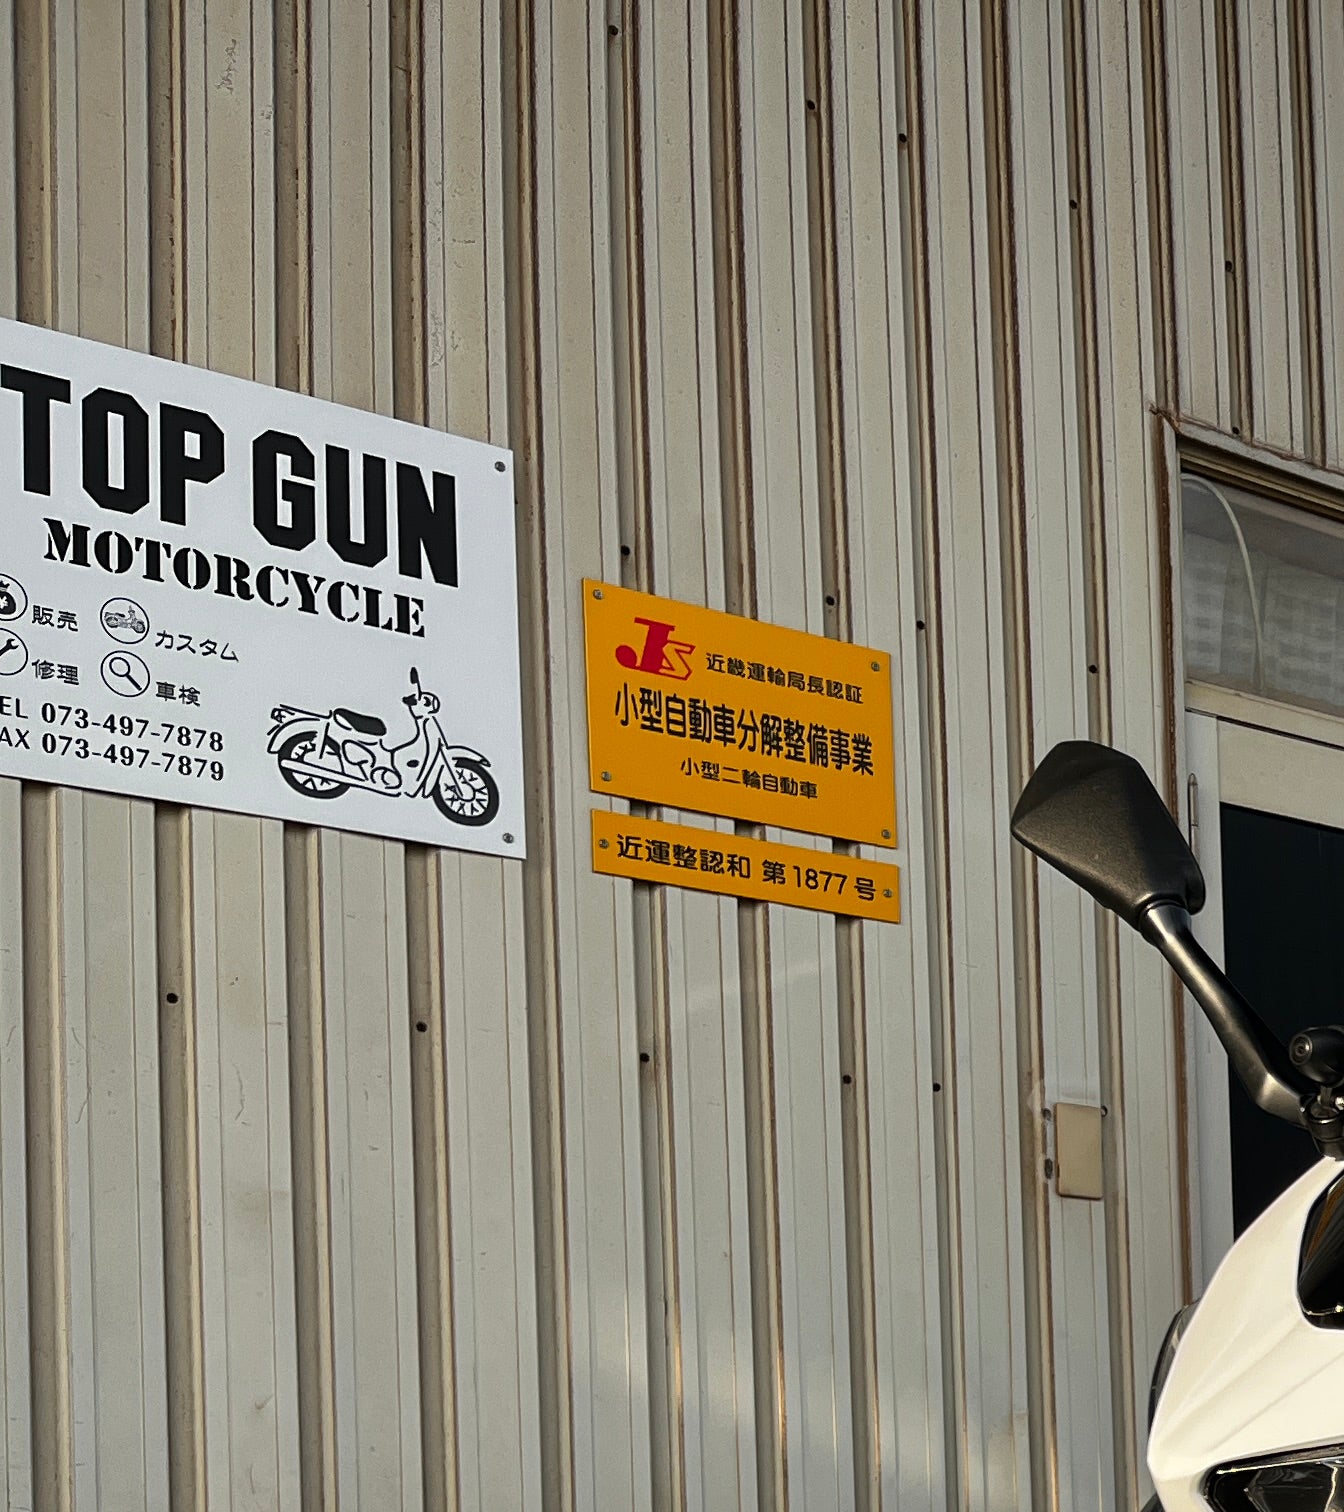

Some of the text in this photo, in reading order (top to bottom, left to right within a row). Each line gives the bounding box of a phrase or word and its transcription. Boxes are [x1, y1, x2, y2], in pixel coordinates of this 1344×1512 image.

[0, 363, 459, 588] TOP GUN
[43, 517, 426, 638] MOTORCYCLE
[32, 604, 240, 663] 販売 カスタム
[32, 658, 201, 707] 修理 車検
[705, 651, 864, 705] 近畿運輸局長認証
[0, 695, 224, 753] EL 073-497-7878
[614, 682, 875, 777] 小型自動車分解整備事業
[0, 726, 225, 782] AX 073-497-7879
[680, 756, 818, 800] 小型二輪自動車
[616, 833, 751, 880] 近運整認和
